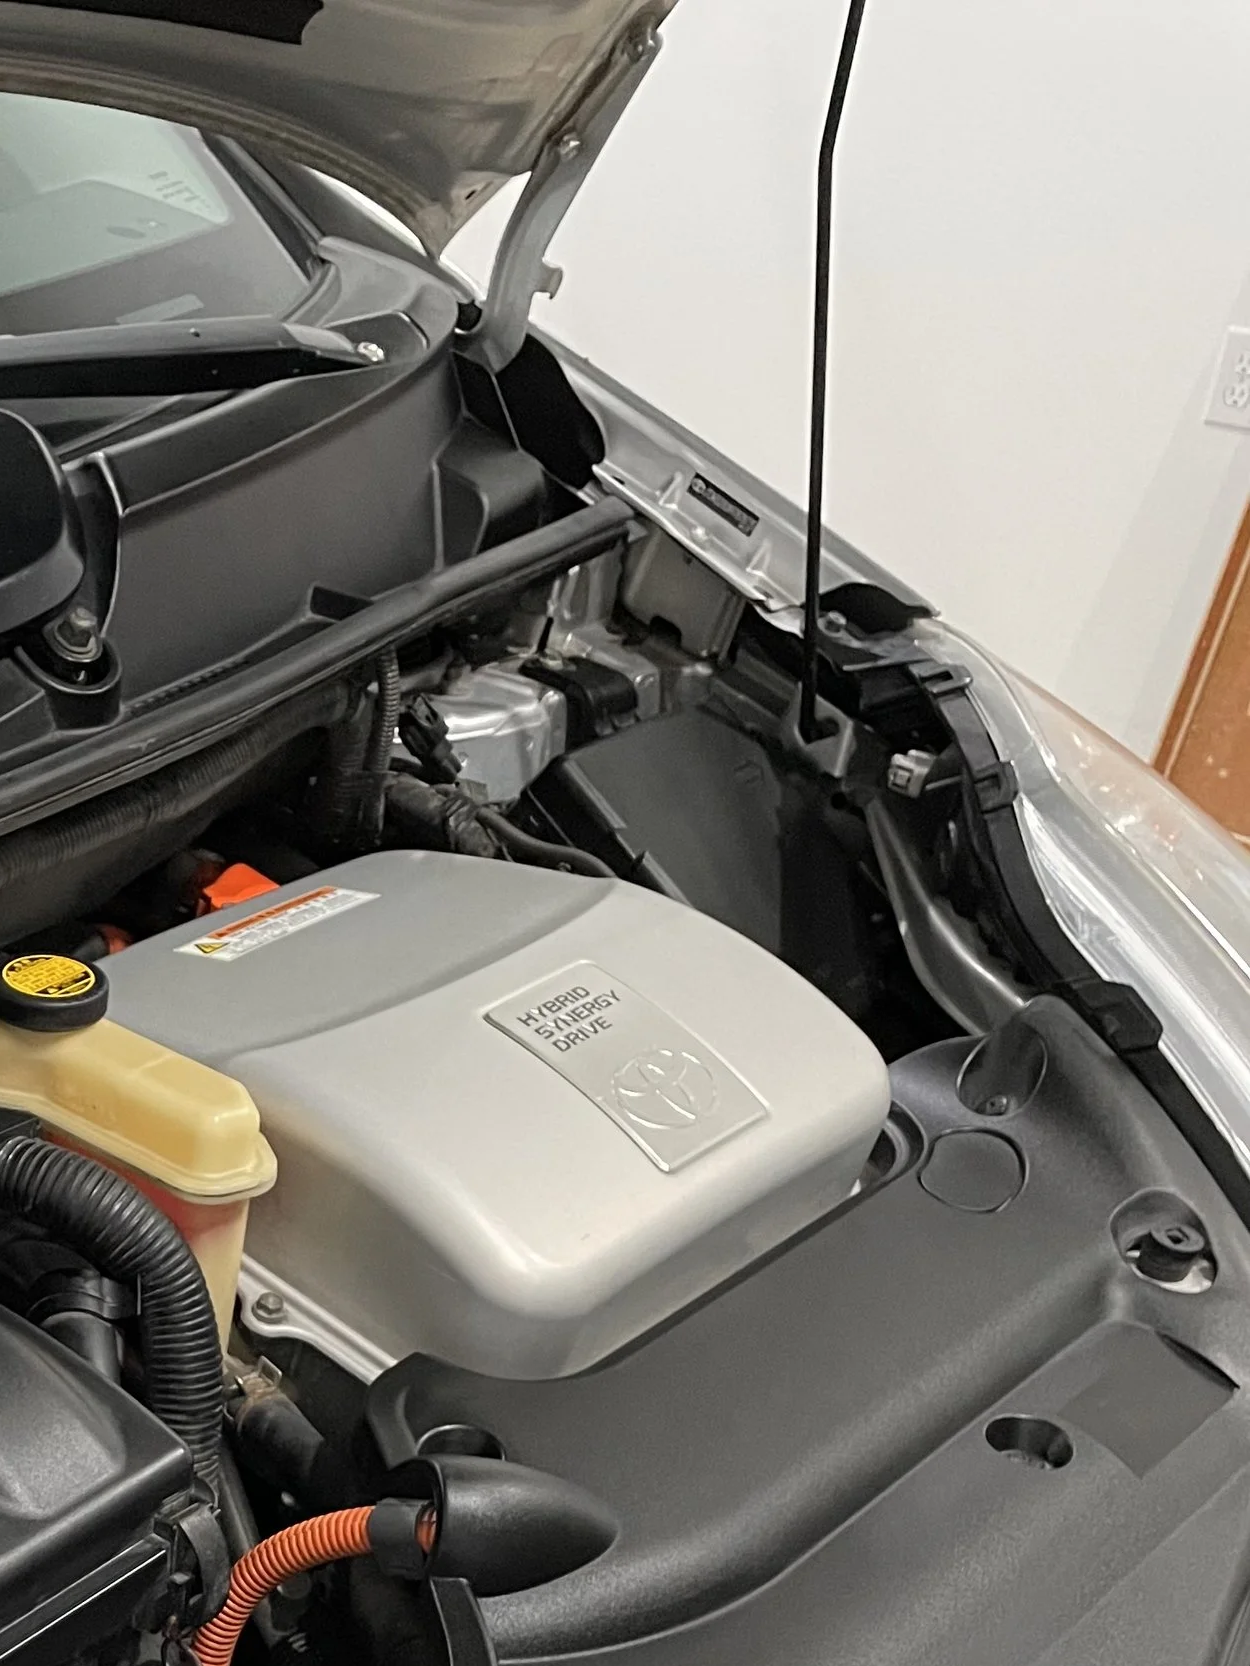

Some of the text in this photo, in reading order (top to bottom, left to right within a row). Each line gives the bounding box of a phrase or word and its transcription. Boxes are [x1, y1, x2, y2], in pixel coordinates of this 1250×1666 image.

[516, 986, 591, 1027] HYBRID
[534, 990, 621, 1040] SYNERGY
[552, 1016, 613, 1053] DRIVE
